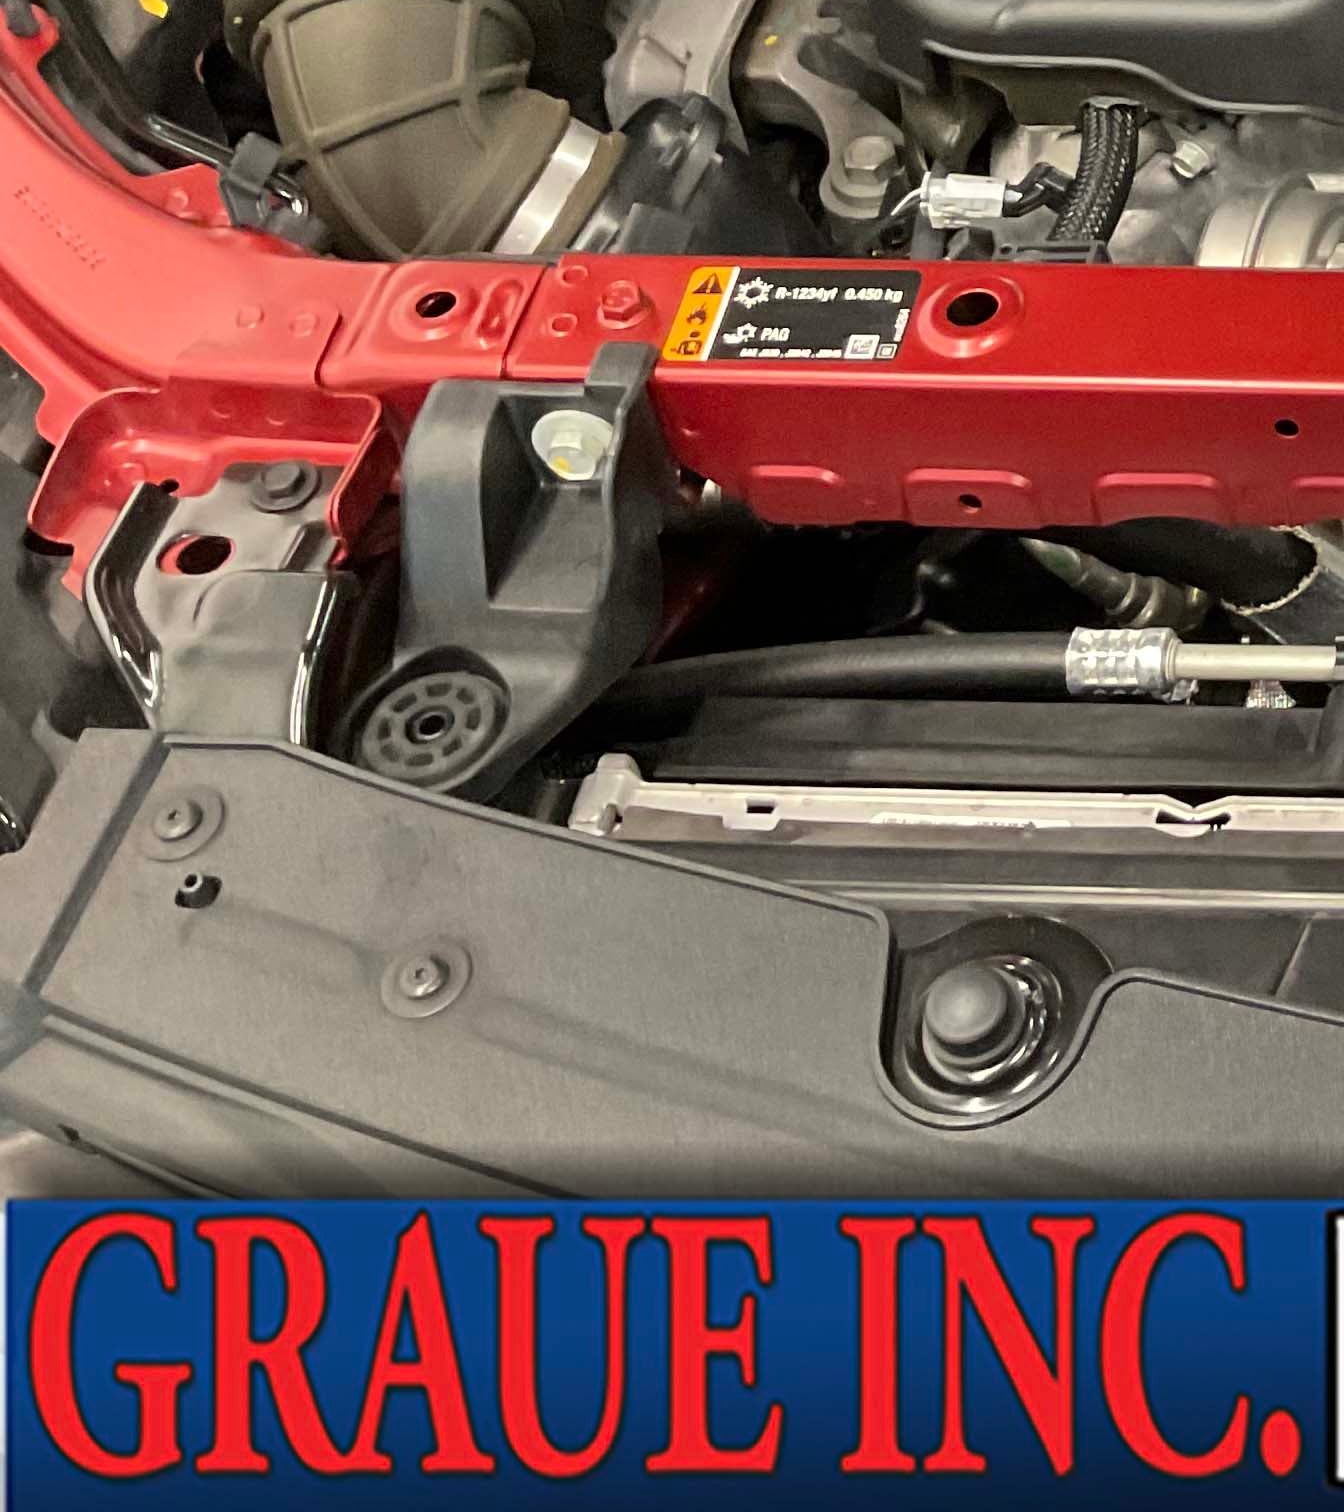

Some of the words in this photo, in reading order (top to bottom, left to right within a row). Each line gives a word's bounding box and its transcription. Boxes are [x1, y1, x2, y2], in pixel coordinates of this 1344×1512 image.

[775, 287, 838, 301] R-1234yf
[844, 287, 884, 301] 0.450
[884, 287, 904, 303] kg
